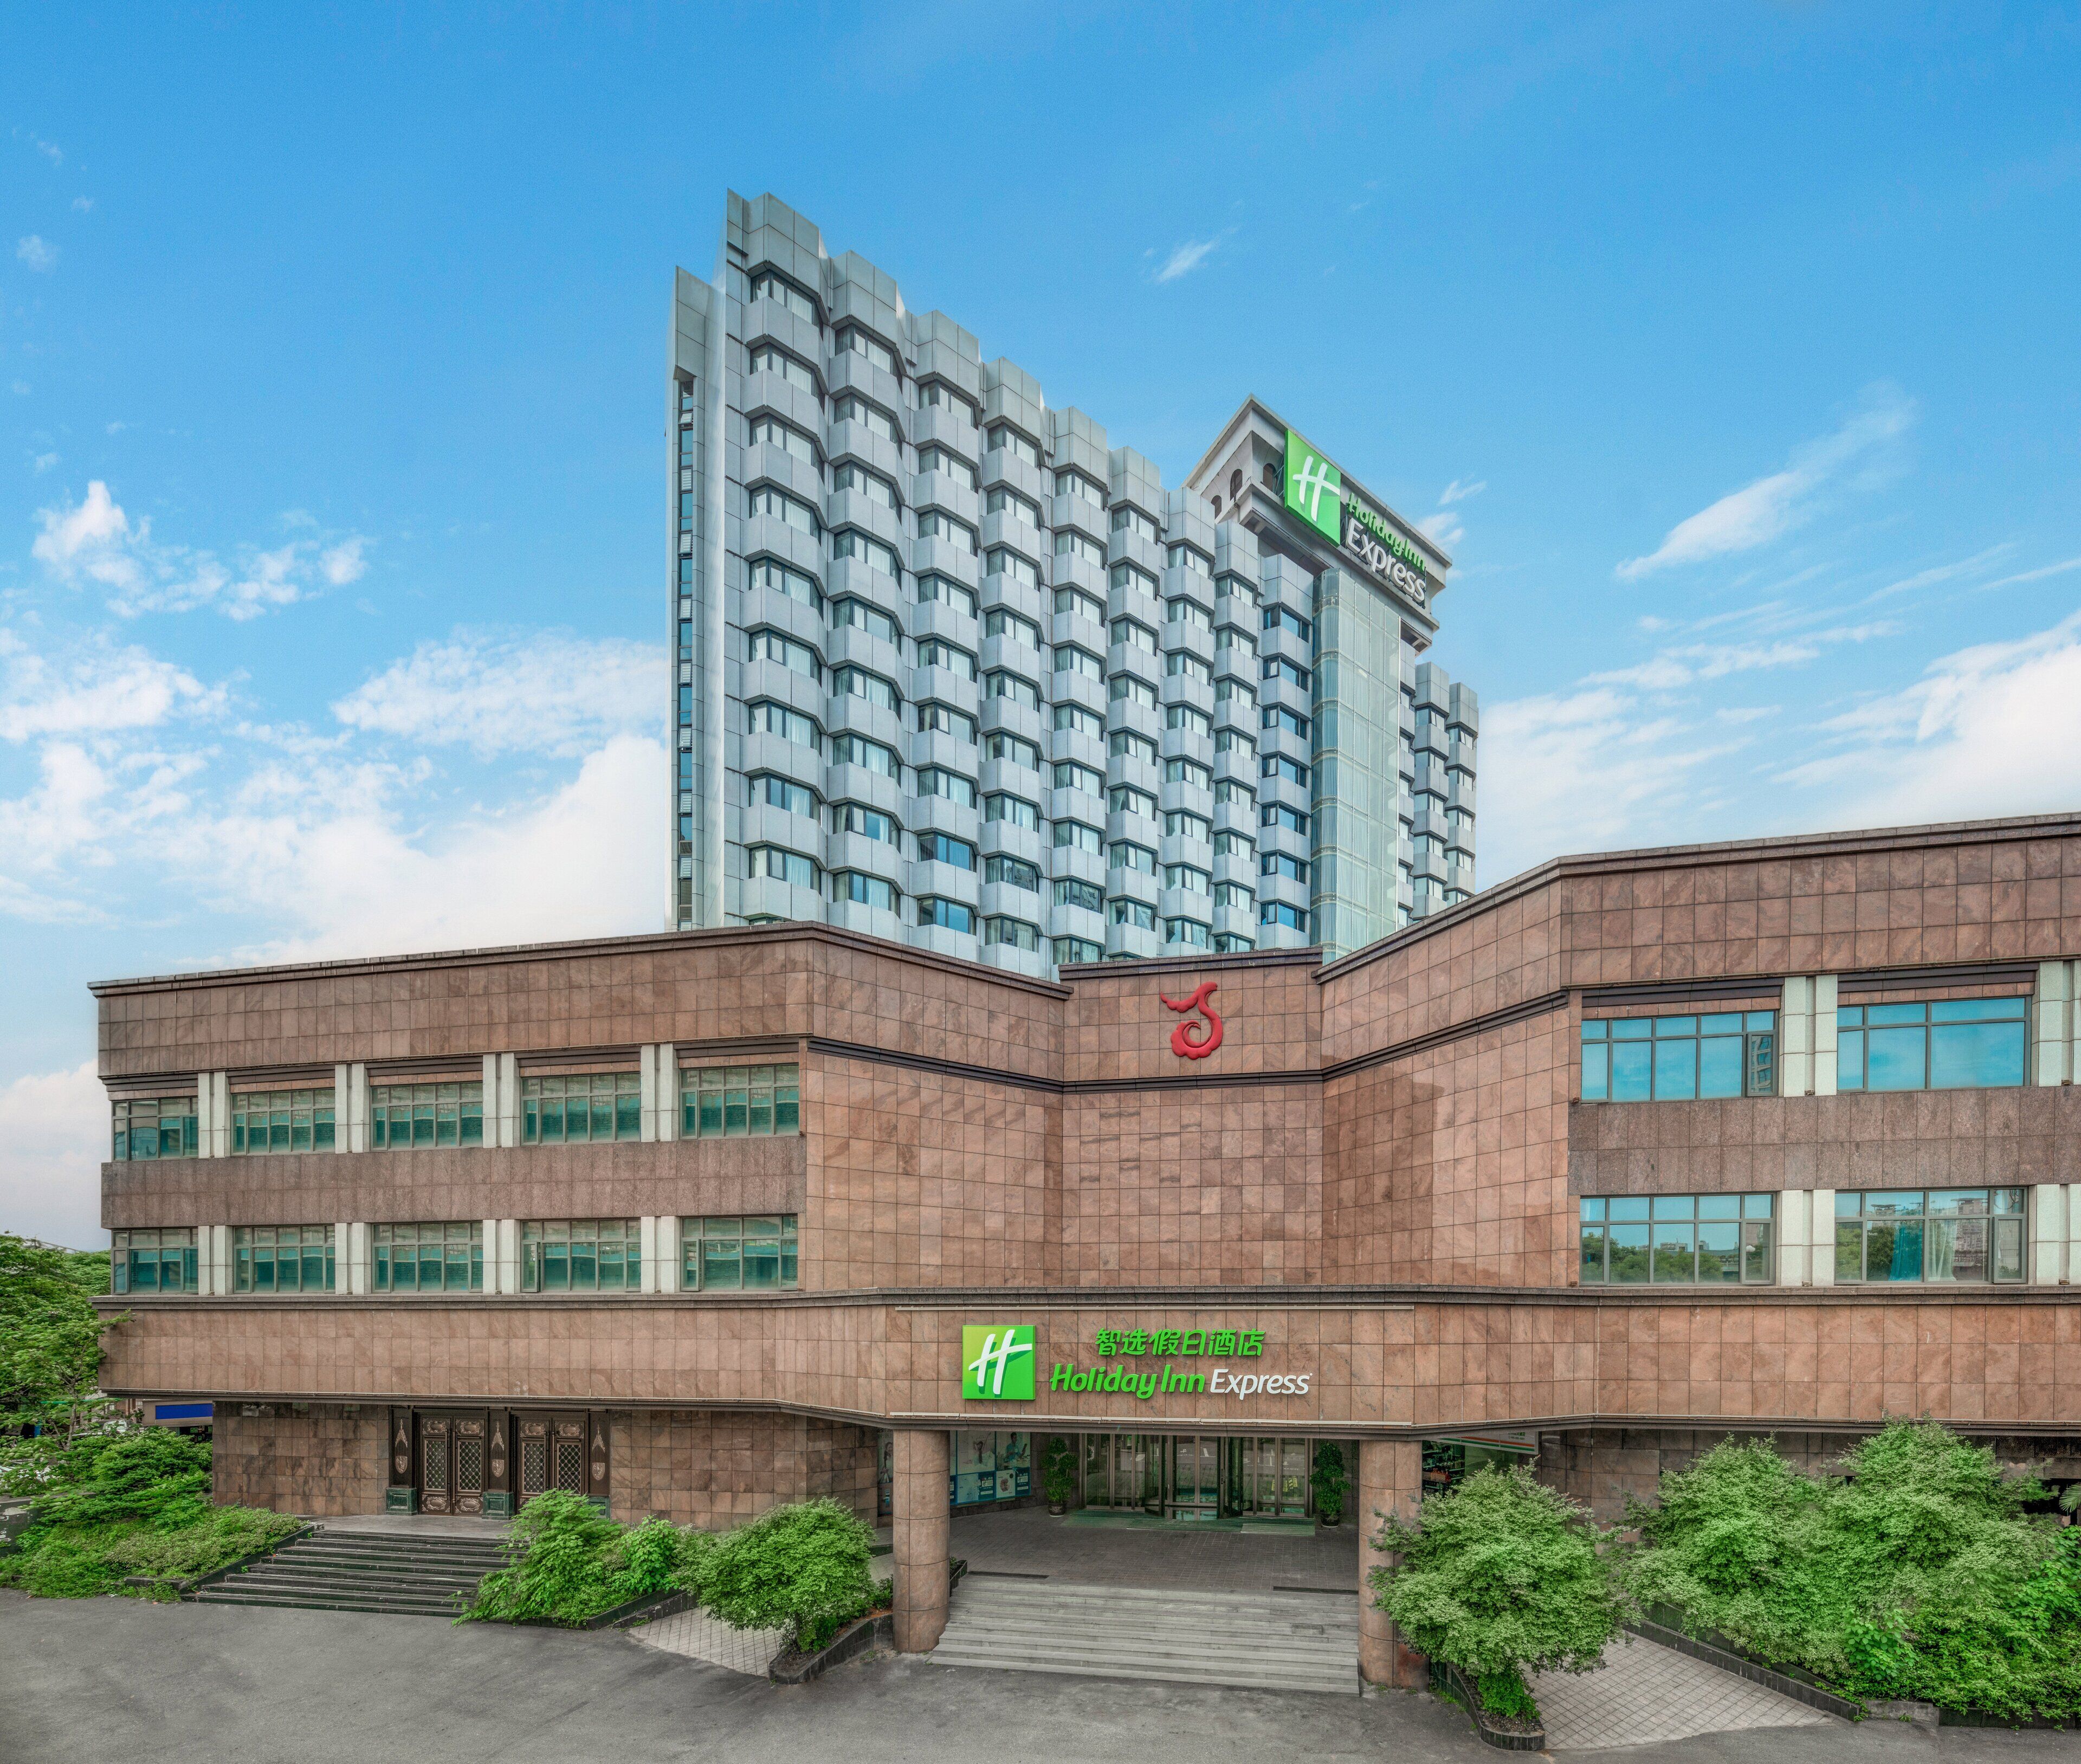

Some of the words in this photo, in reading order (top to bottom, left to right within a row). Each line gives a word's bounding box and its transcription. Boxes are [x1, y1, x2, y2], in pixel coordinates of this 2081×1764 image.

[1292, 455, 1340, 521] H
[1346, 518, 1426, 603] Express
[1347, 492, 1403, 557] Holiday
[1404, 538, 1425, 572] Inn
[968, 1329, 1032, 1394] H
[1095, 1328, 1265, 1356] 智选假日酒店
[1049, 1364, 1158, 1399] Holiday
[1160, 1365, 1205, 1393] Inn
[1210, 1369, 1310, 1400] Express
